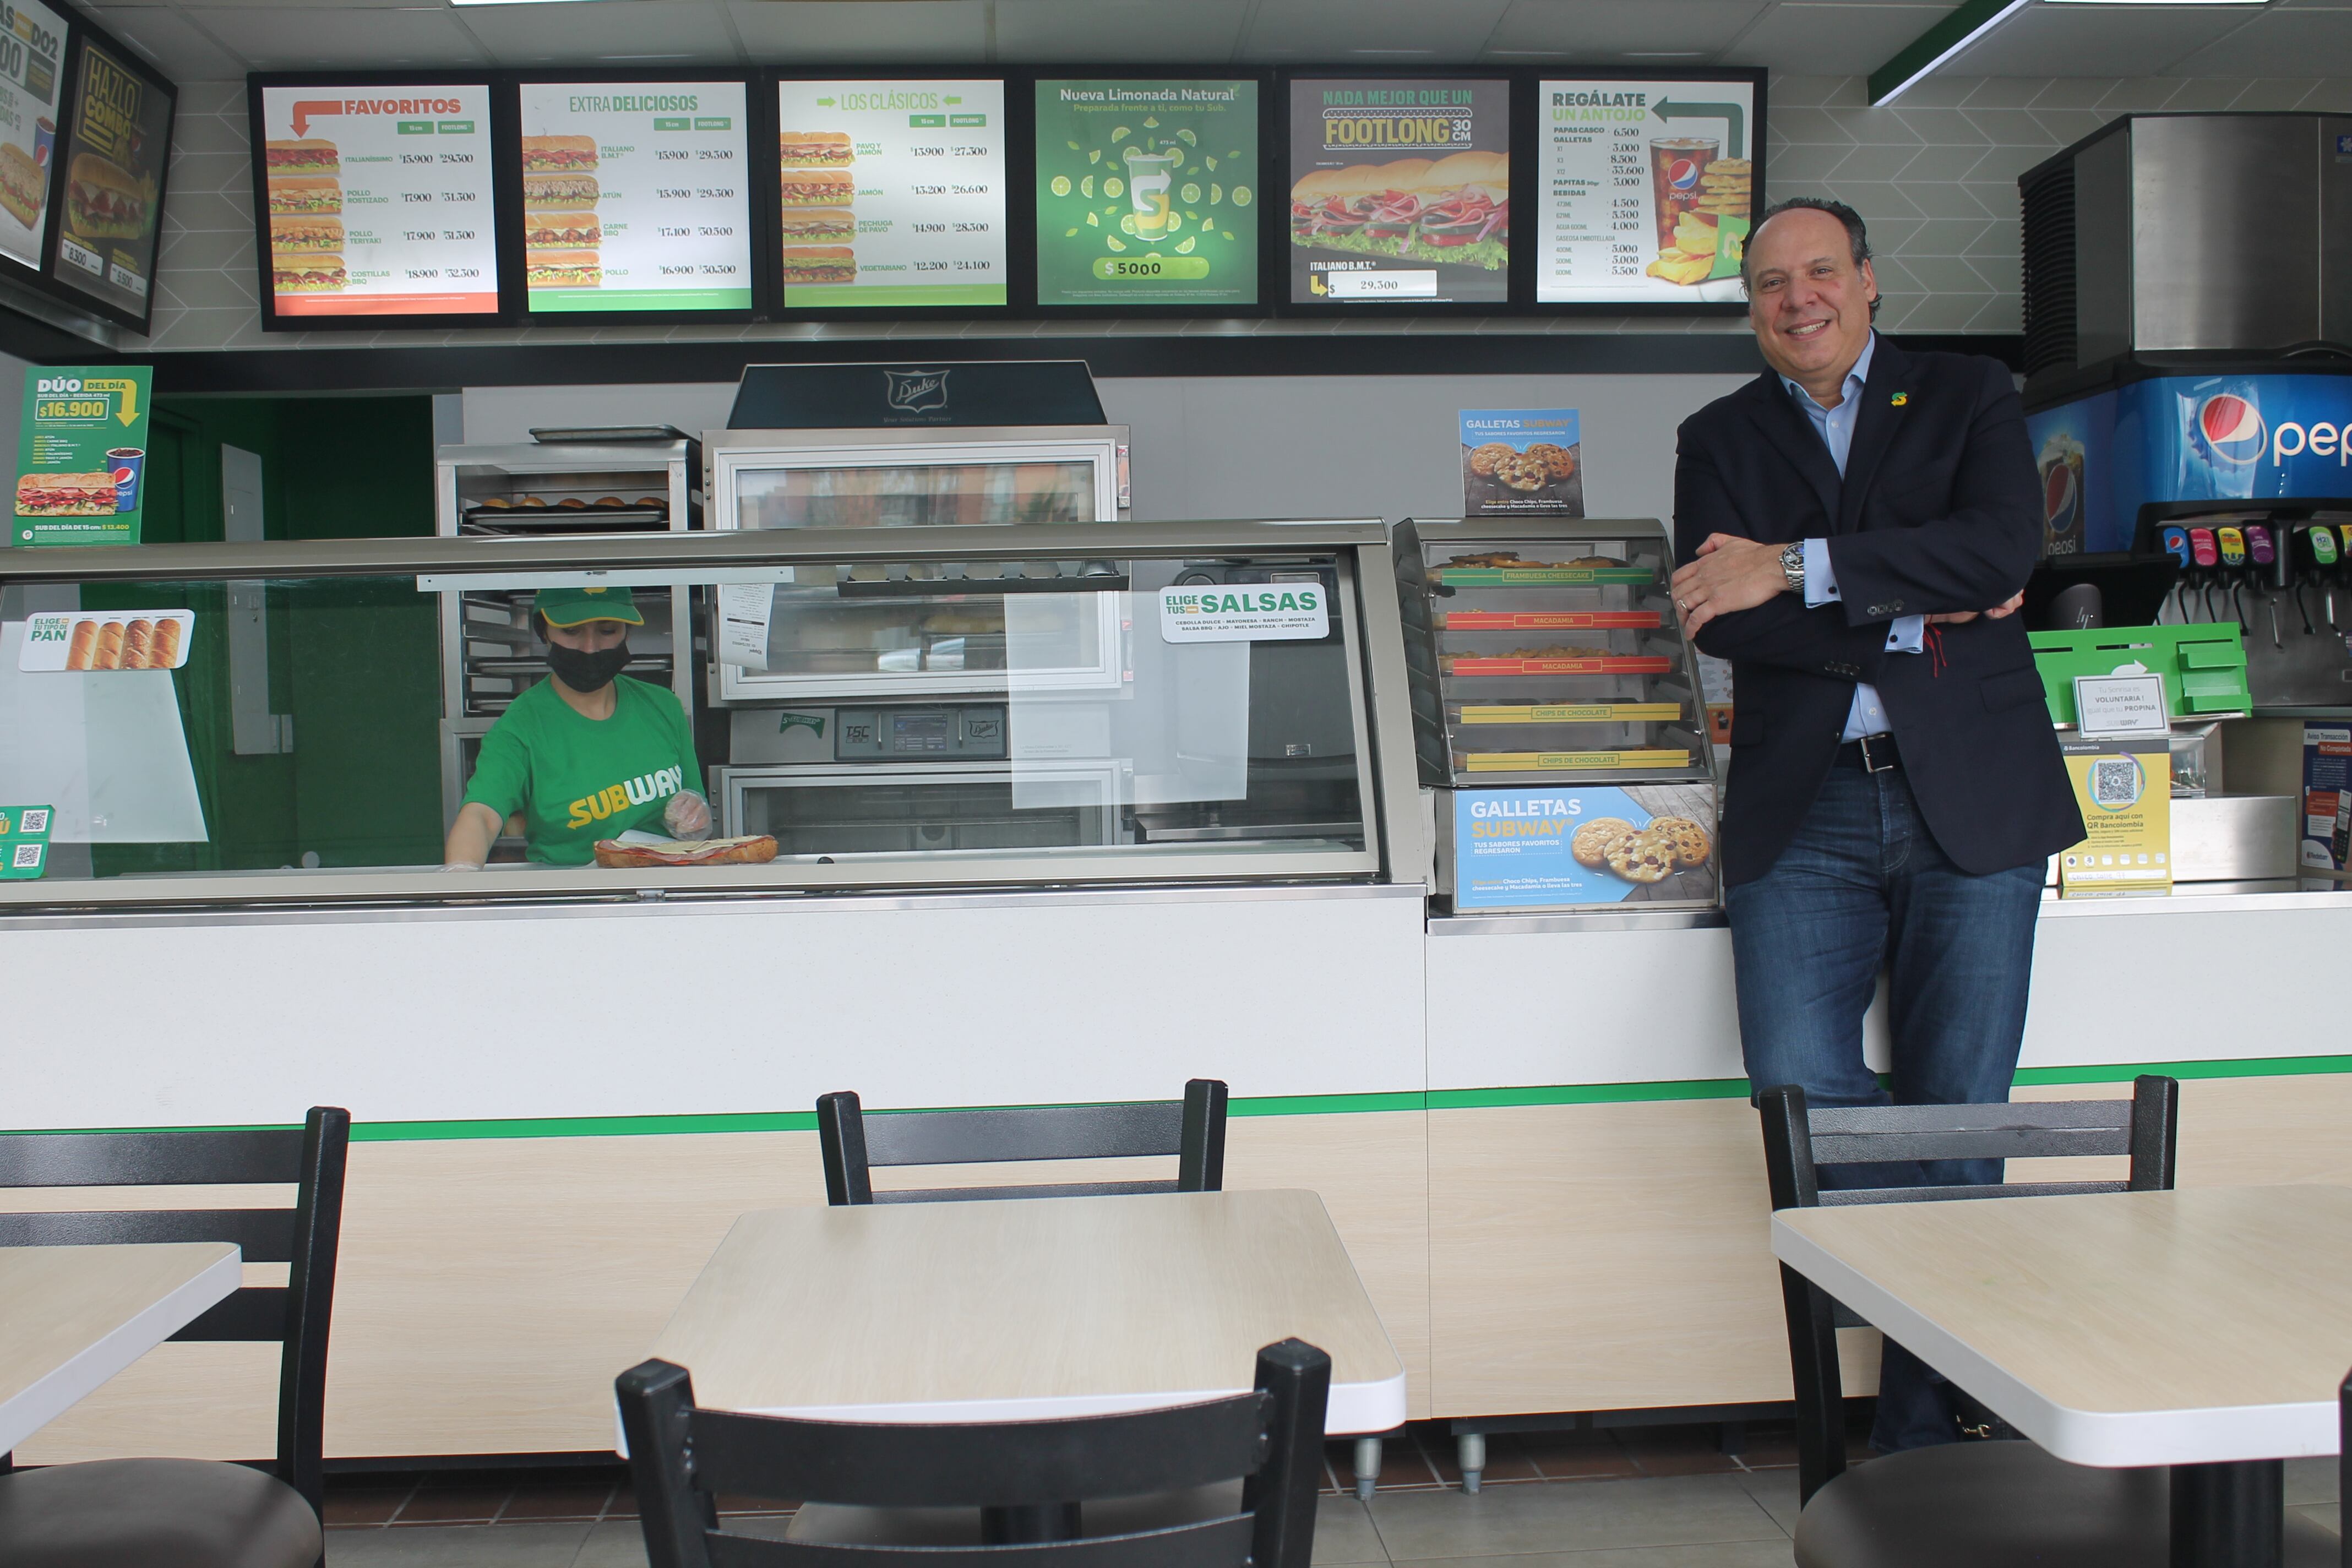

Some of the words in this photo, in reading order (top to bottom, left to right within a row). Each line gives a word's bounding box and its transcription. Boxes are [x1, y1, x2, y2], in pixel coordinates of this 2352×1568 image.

[88, 56, 135, 119] HAZLO
[1060, 89, 1104, 101] Nueva
[1109, 88, 1177, 101] Limonada
[1182, 88, 1234, 101] Natural
[1323, 91, 1364, 105] NADA
[1368, 90, 1415, 105] MEJOR
[1419, 90, 1449, 105] QUE
[1452, 90, 1472, 104] UN
[1553, 90, 1646, 107] REGÁLATE
[569, 96, 611, 112] EXTRA
[612, 95, 698, 111] DELICIOSOS
[841, 94, 868, 110] LOS
[870, 90, 938, 110] CLÁSICOS
[345, 99, 461, 115] FAVORITOS
[1074, 104, 1119, 112] Preparada
[85, 95, 131, 140] COMBO
[1553, 108, 1576, 121] UN
[1580, 108, 1646, 122] ANTOJO
[1452, 119, 1471, 131] 30
[1326, 119, 1449, 144] FOOTLONG
[1452, 132, 1471, 141] CM
[1614, 128, 1638, 137] 6.500
[1610, 155, 1637, 164] 8.500
[1612, 166, 1644, 175] 33.600
[1669, 191, 1697, 201] pepsi
[1611, 199, 1638, 208] 4.500
[1611, 221, 1638, 230] 4.000
[1612, 244, 1638, 253] 5.000
[1612, 255, 1638, 264] 5.000
[1118, 263, 1161, 275] 5000
[1310, 262, 1347, 271] ITALIANO
[1612, 266, 1638, 275] 5.500
[1361, 281, 1398, 290] 29.300
[37, 377, 81, 392] DÚO
[896, 378, 939, 402] Duke
[40, 401, 104, 417] $16.900
[1466, 420, 1520, 428] GALLETAS
[1548, 571, 1589, 579] CHEESECAKE
[1166, 595, 1199, 605] ELIGE
[1201, 592, 1317, 613] SALSAS
[1166, 606, 1185, 614] TUS
[31, 630, 67, 641] PAN
[1567, 708, 1607, 716] CHOCOLATE
[1575, 755, 1615, 764] CHOCOLATE
[567, 764, 683, 830] SUBWAY
[1471, 798, 1581, 818] GALLETAS
